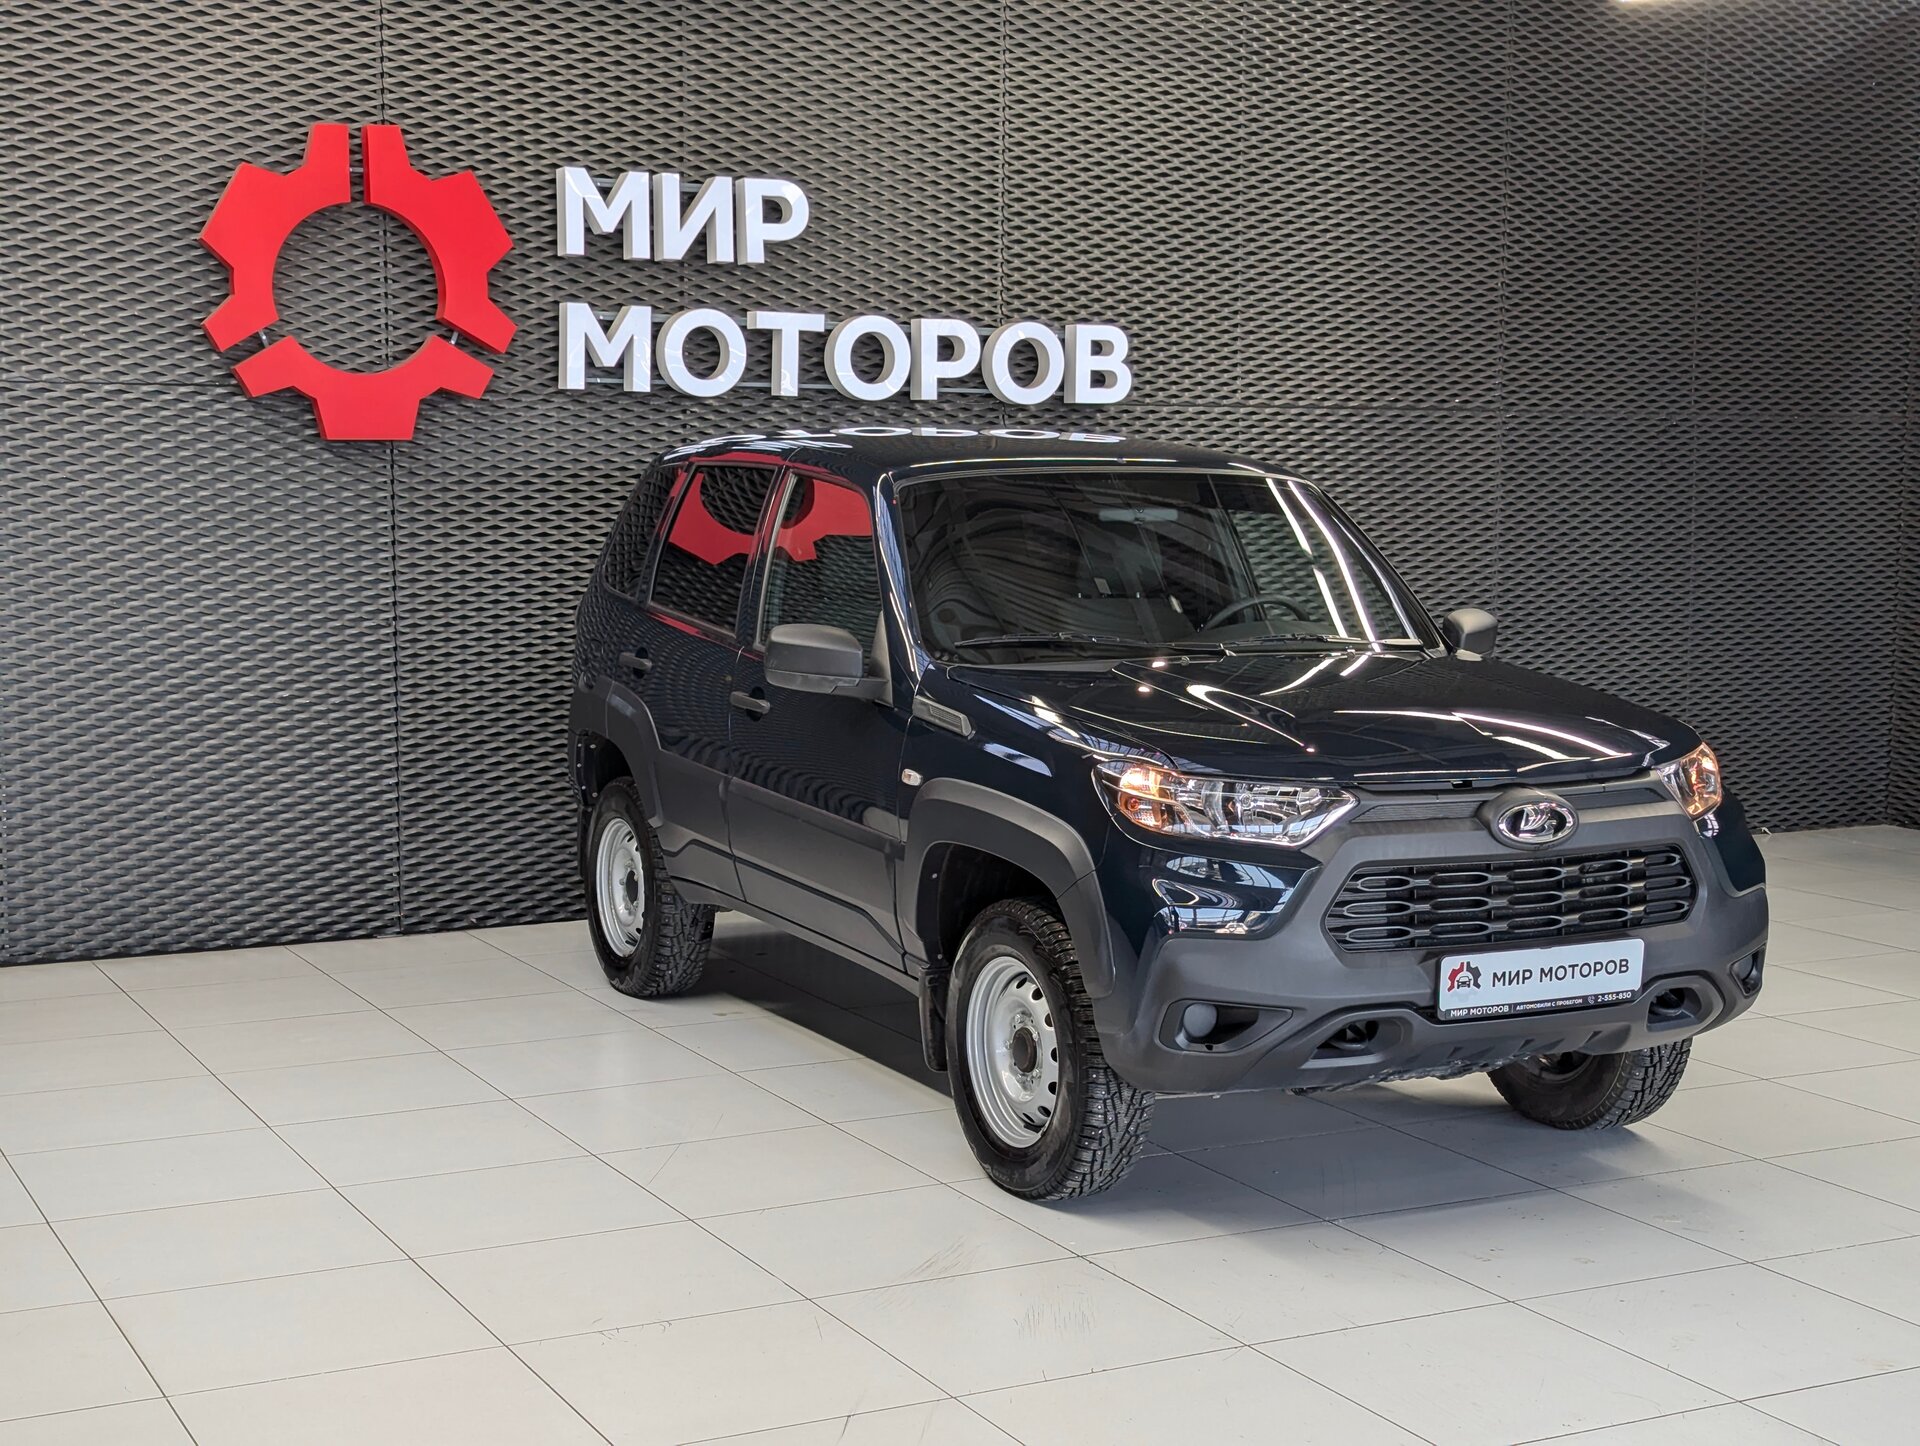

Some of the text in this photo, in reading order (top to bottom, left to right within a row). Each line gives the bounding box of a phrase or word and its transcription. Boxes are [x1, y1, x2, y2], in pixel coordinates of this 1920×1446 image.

[556, 166, 810, 264] МИР
[557, 302, 1133, 404] МОТОРОВ
[1450, 1008, 1468, 1017] МИР
[1469, 1005, 1509, 1015] МОТОРОВ
[1516, 1002, 1551, 1010] АВТОМОБИЛИ
[1597, 991, 1632, 1002] 2-555-850
[1492, 958, 1630, 987] МИР МОТОРОВ
